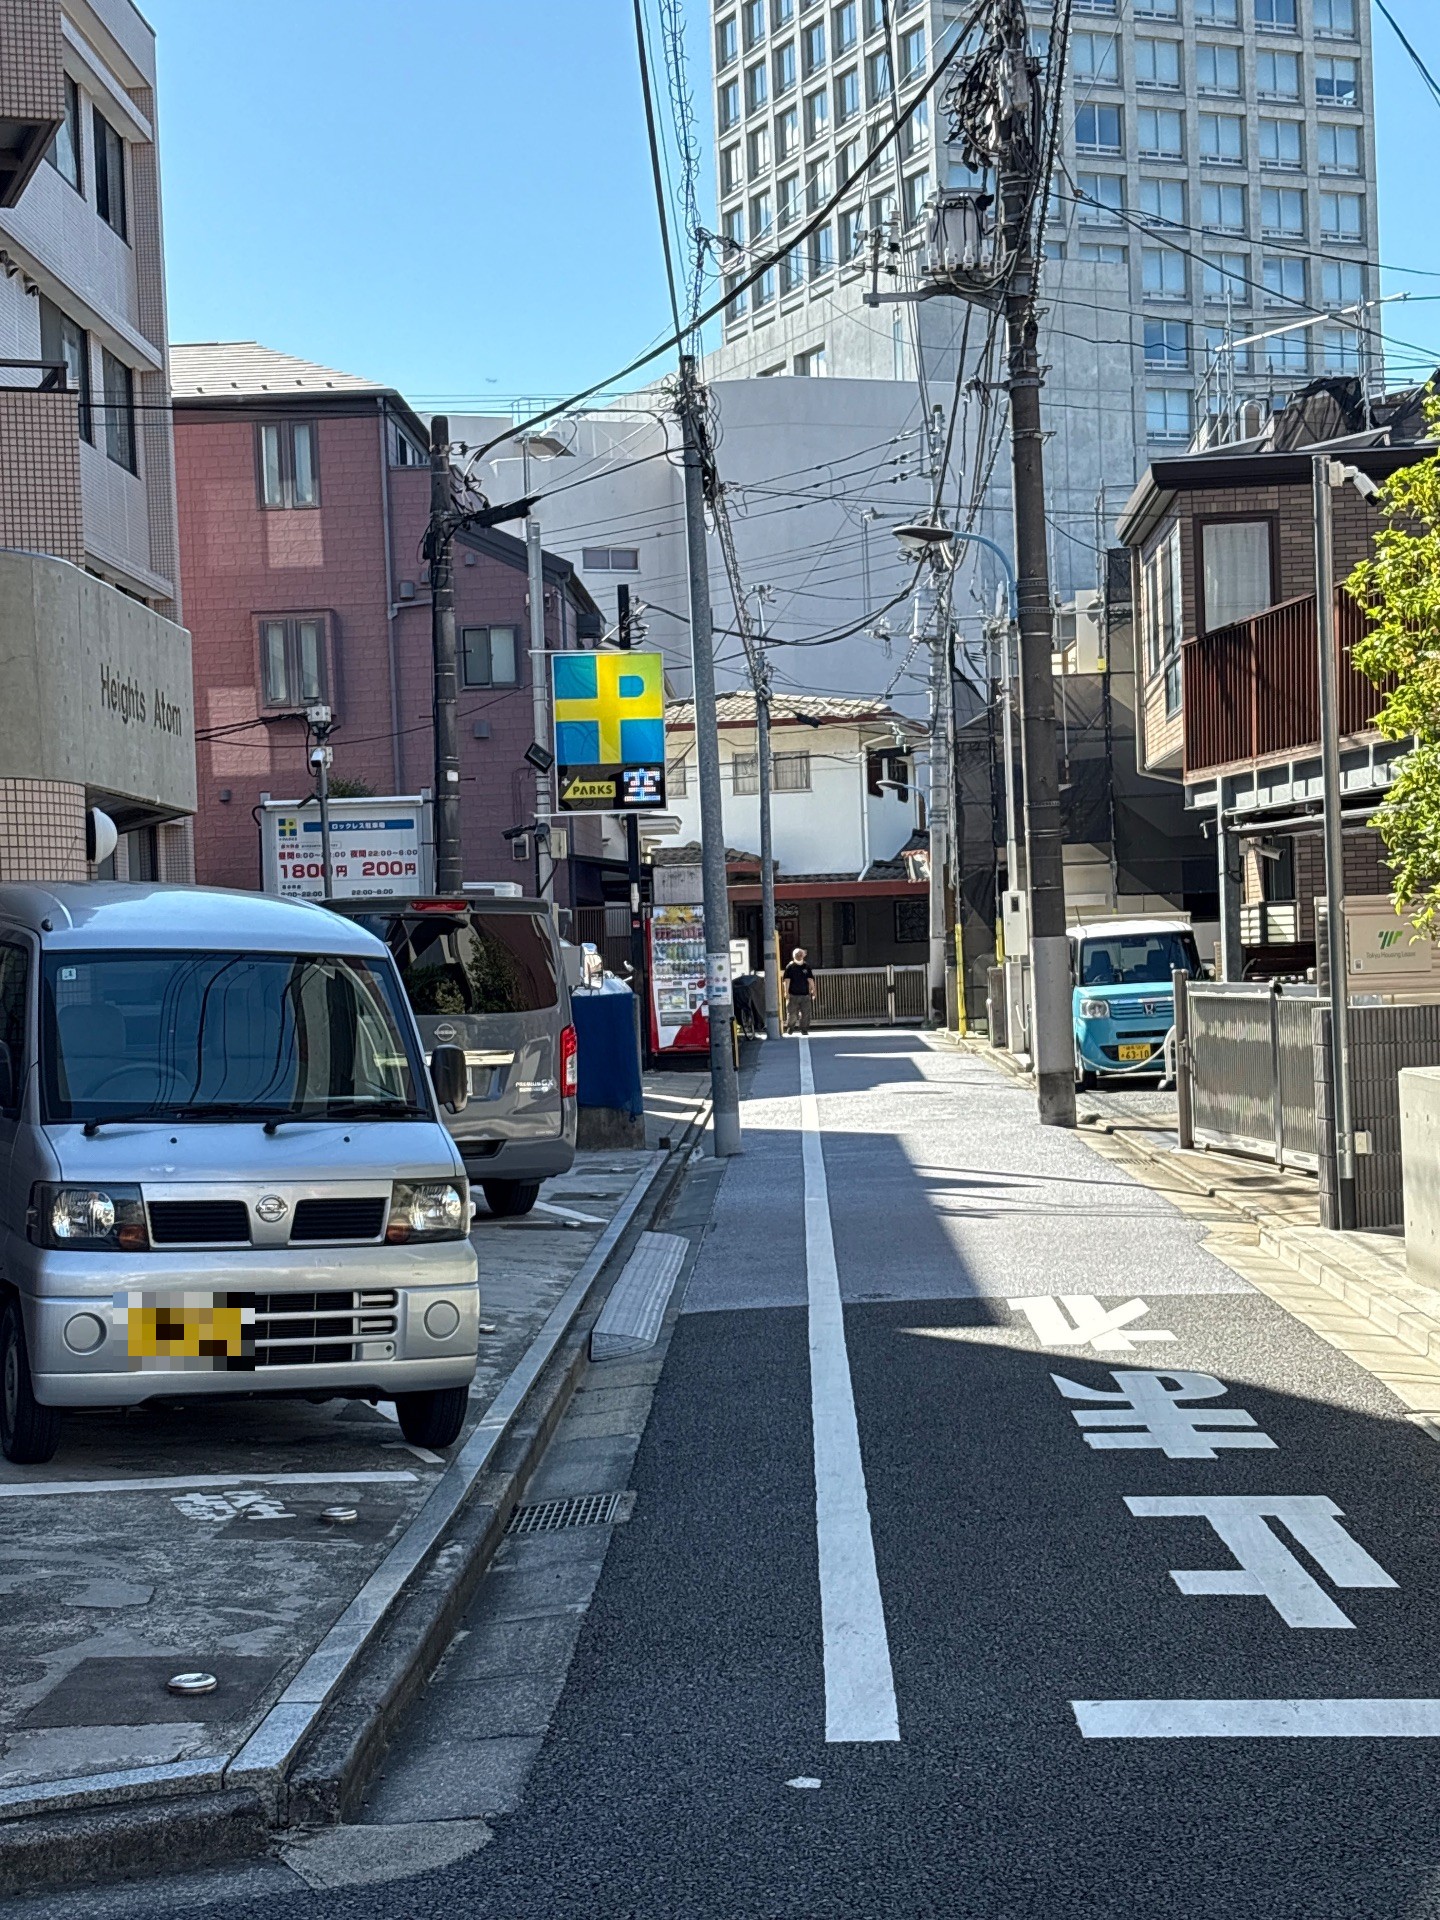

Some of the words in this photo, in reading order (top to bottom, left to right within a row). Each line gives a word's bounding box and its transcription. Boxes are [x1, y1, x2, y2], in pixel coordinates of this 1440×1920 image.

[100, 662, 146, 724] Heights
[154, 688, 182, 736] Atom
[572, 785, 613, 795] PARKS
[623, 767, 661, 802] 空
[362, 861, 416, 876] 200円
[1007, 1294, 1401, 1630] 止まれ
